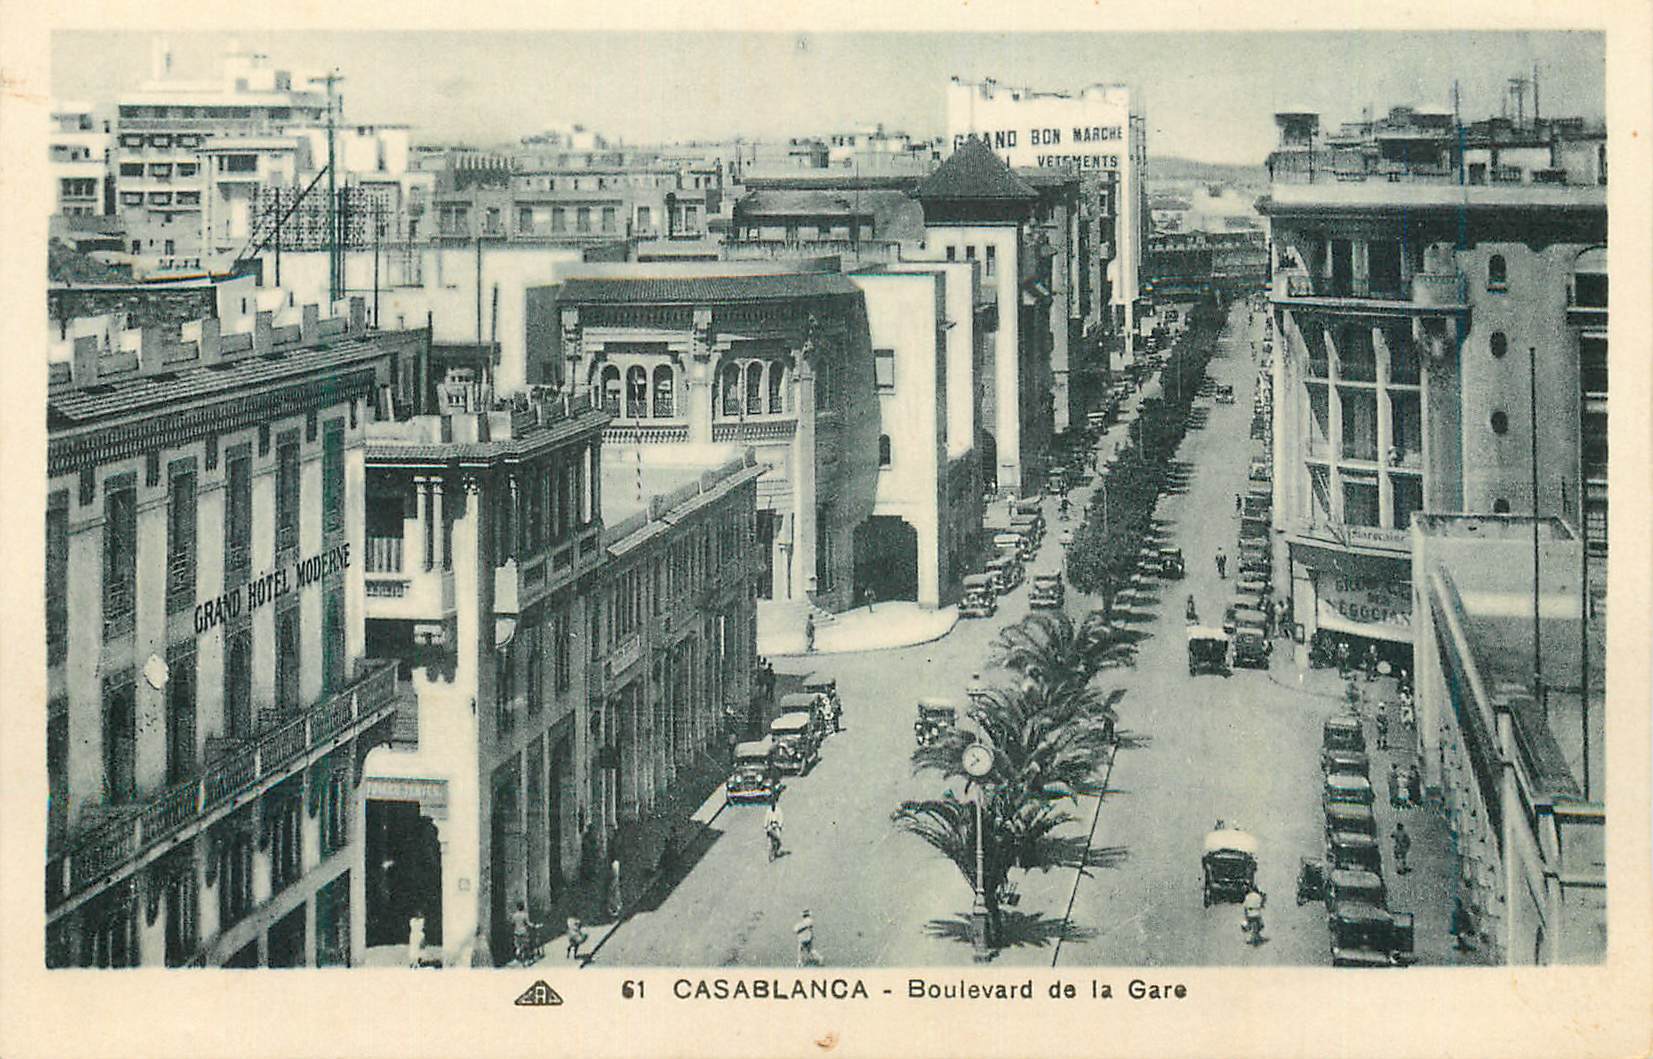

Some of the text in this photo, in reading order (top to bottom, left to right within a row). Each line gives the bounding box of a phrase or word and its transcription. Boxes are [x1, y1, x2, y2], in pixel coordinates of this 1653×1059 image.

[954, 131, 1016, 151] GAND
[1031, 128, 1061, 145] BON
[194, 588, 241, 634] GRAND
[296, 543, 350, 588] MODERNE
